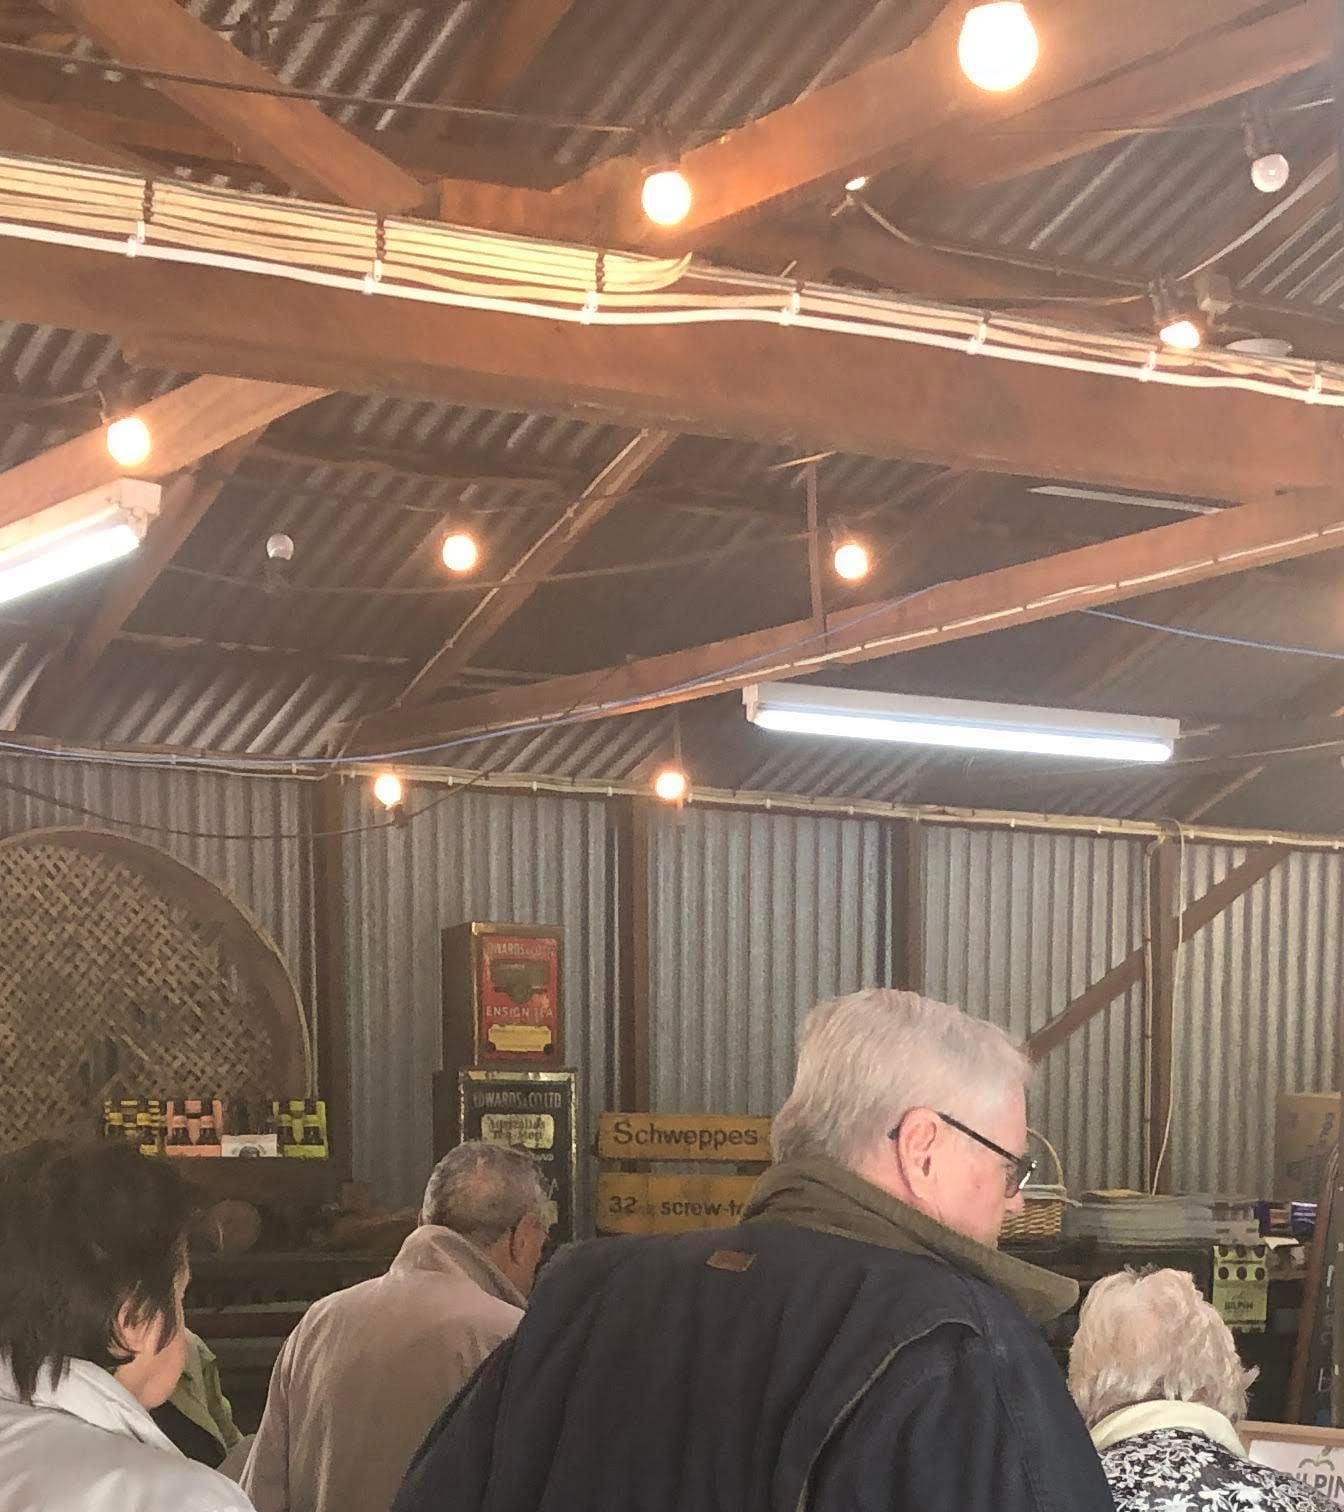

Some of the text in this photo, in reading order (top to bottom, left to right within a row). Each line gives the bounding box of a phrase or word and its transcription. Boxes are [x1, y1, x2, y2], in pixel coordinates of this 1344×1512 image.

[486, 1006, 529, 1017] ENSIGN
[613, 1119, 759, 1150] Schweppes
[608, 1195, 638, 1214] 32
